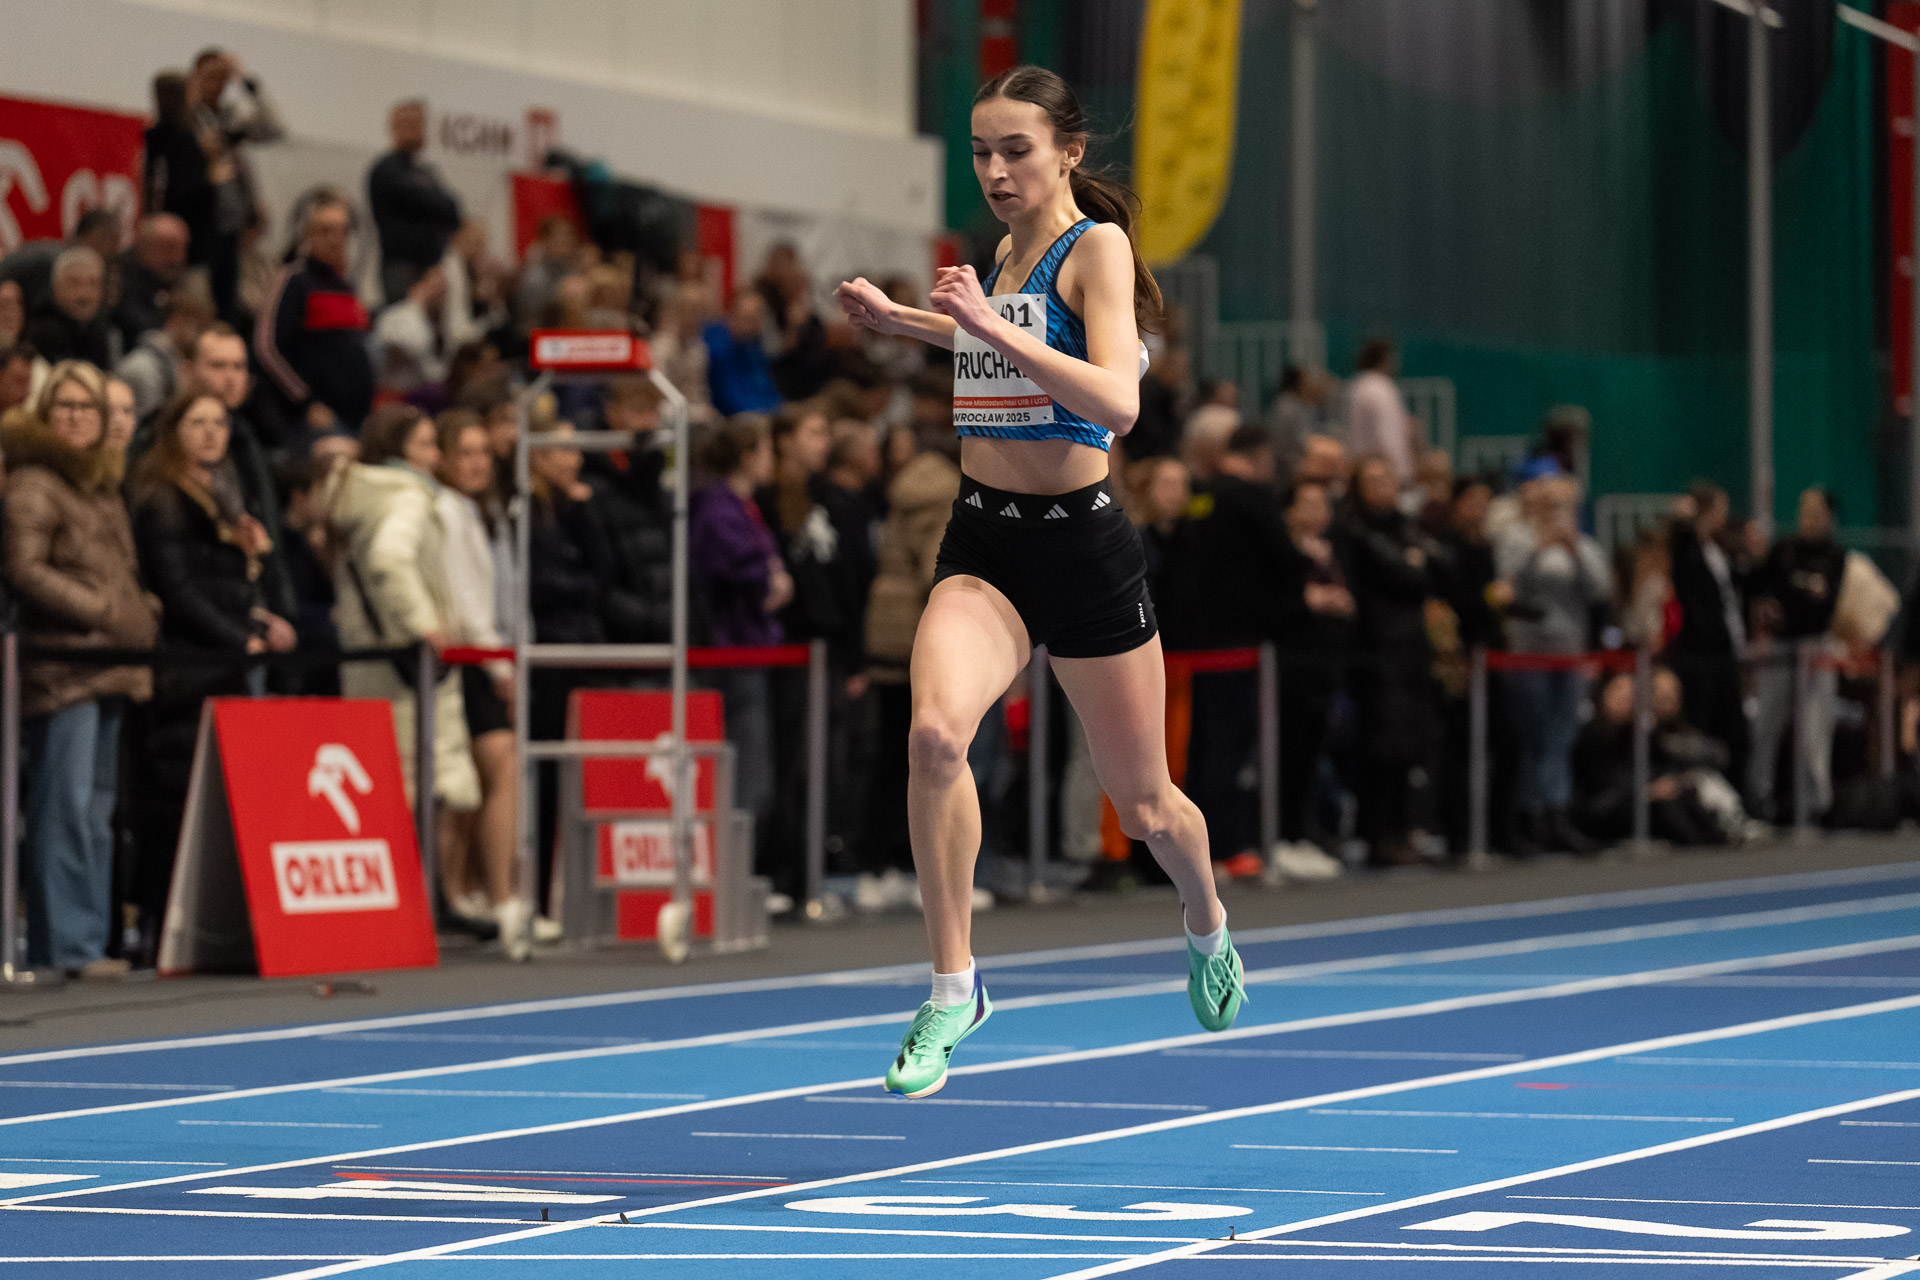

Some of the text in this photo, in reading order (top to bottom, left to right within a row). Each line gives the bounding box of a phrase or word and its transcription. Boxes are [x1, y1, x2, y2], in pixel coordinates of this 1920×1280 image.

[955, 351, 1028, 379] RUCHA
[1017, 398, 1029, 406] U18
[1034, 397, 1049, 405] U20
[1005, 412, 1031, 423] 2025
[286, 856, 386, 897] ORLEN
[784, 1195, 1255, 1222] 3
[1399, 1210, 1912, 1241] 2
